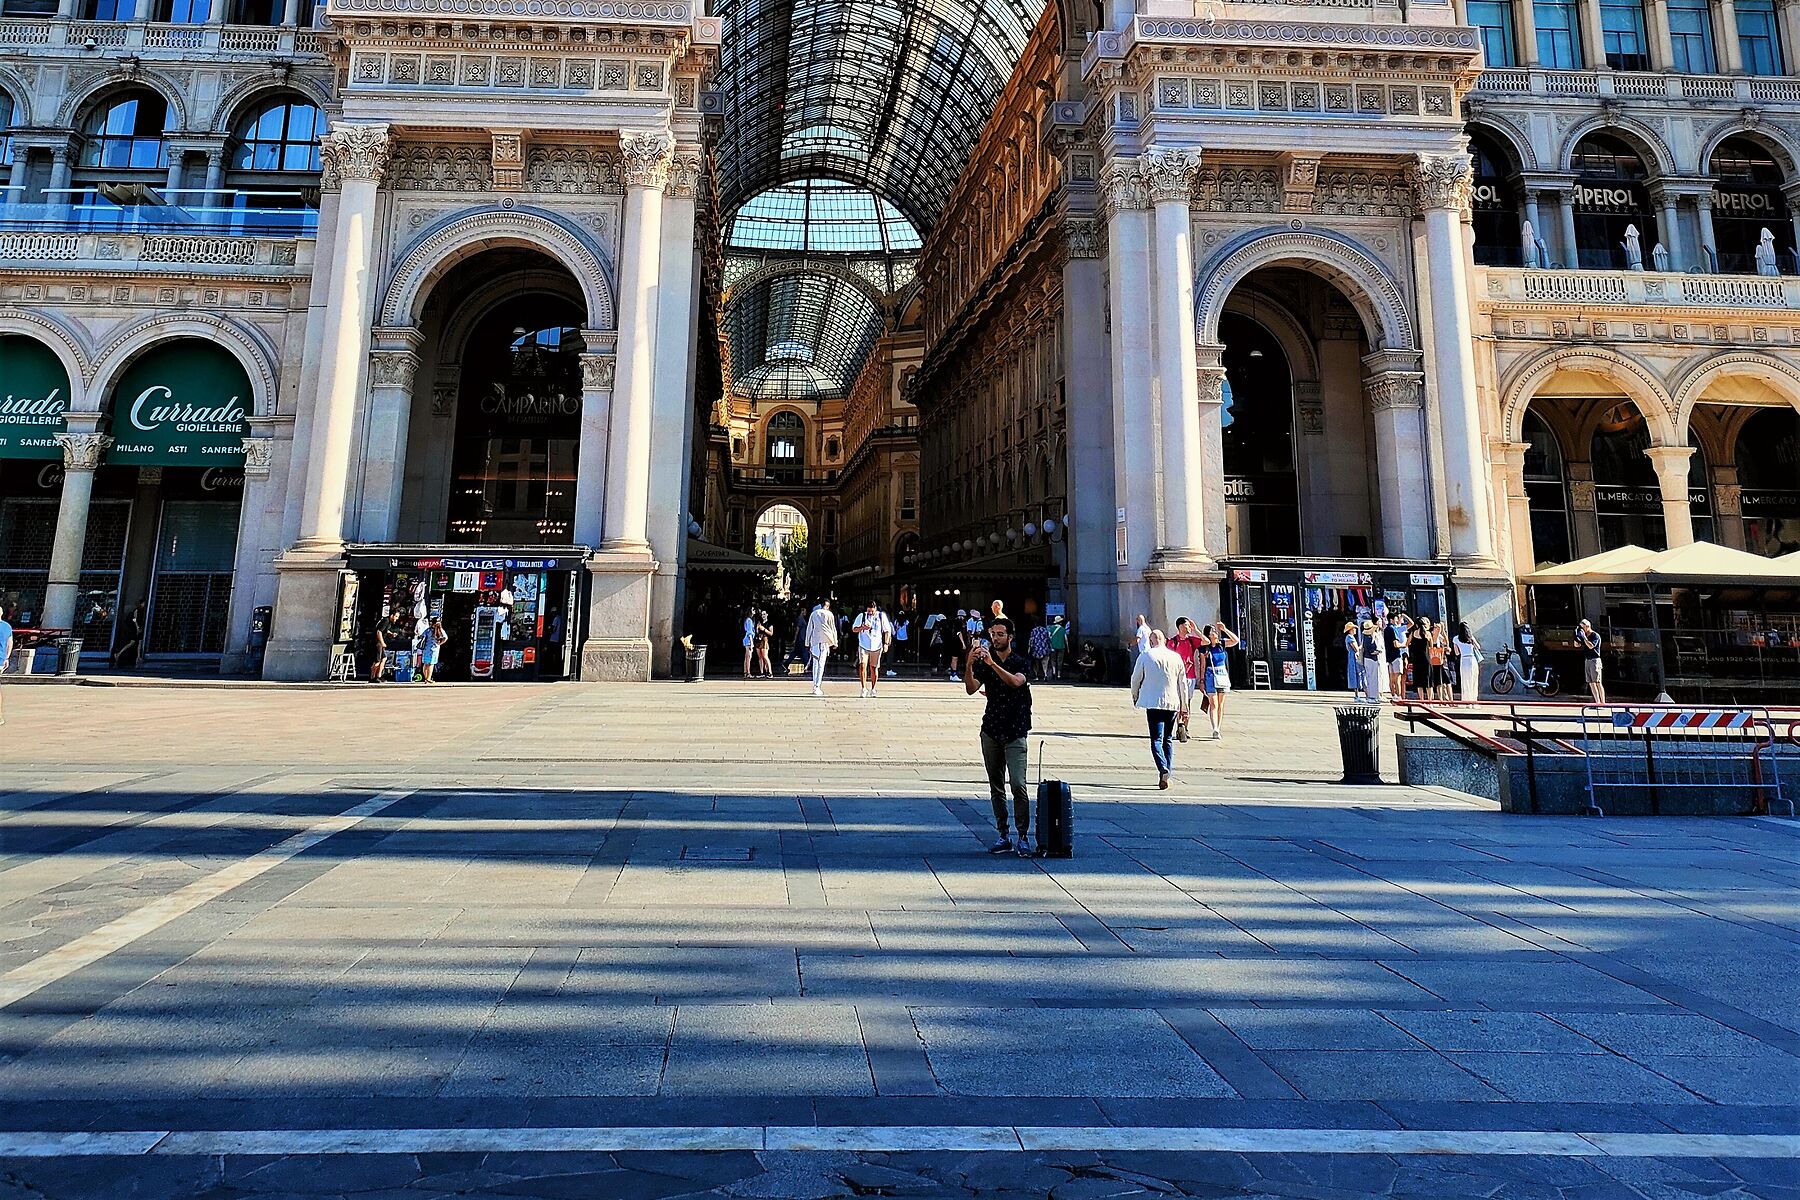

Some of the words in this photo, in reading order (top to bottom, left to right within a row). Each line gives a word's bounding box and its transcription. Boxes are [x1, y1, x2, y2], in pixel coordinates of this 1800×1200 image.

[1572, 184, 1638, 206] APEROL
[1711, 189, 1775, 211] APEROL
[0, 388, 65, 415] rado
[130, 385, 247, 430] Currado
[480, 395, 579, 415] CAMPARINO
[0, 415, 62, 425] GIOIELLERIE
[176, 423, 242, 433] GIOIELLERIE
[116, 444, 154, 453] MILANO
[168, 445, 187, 453] ASTI
[201, 446, 246, 454] SANREMO
[201, 467, 244, 491] Curra
[1224, 479, 1255, 496] otta
[1598, 492, 1607, 500] IL
[1607, 492, 1653, 501] MERCATO
[1742, 495, 1752, 504] IL
[1752, 496, 1797, 504] MERCATO
[455, 559, 494, 570] ITALIA
